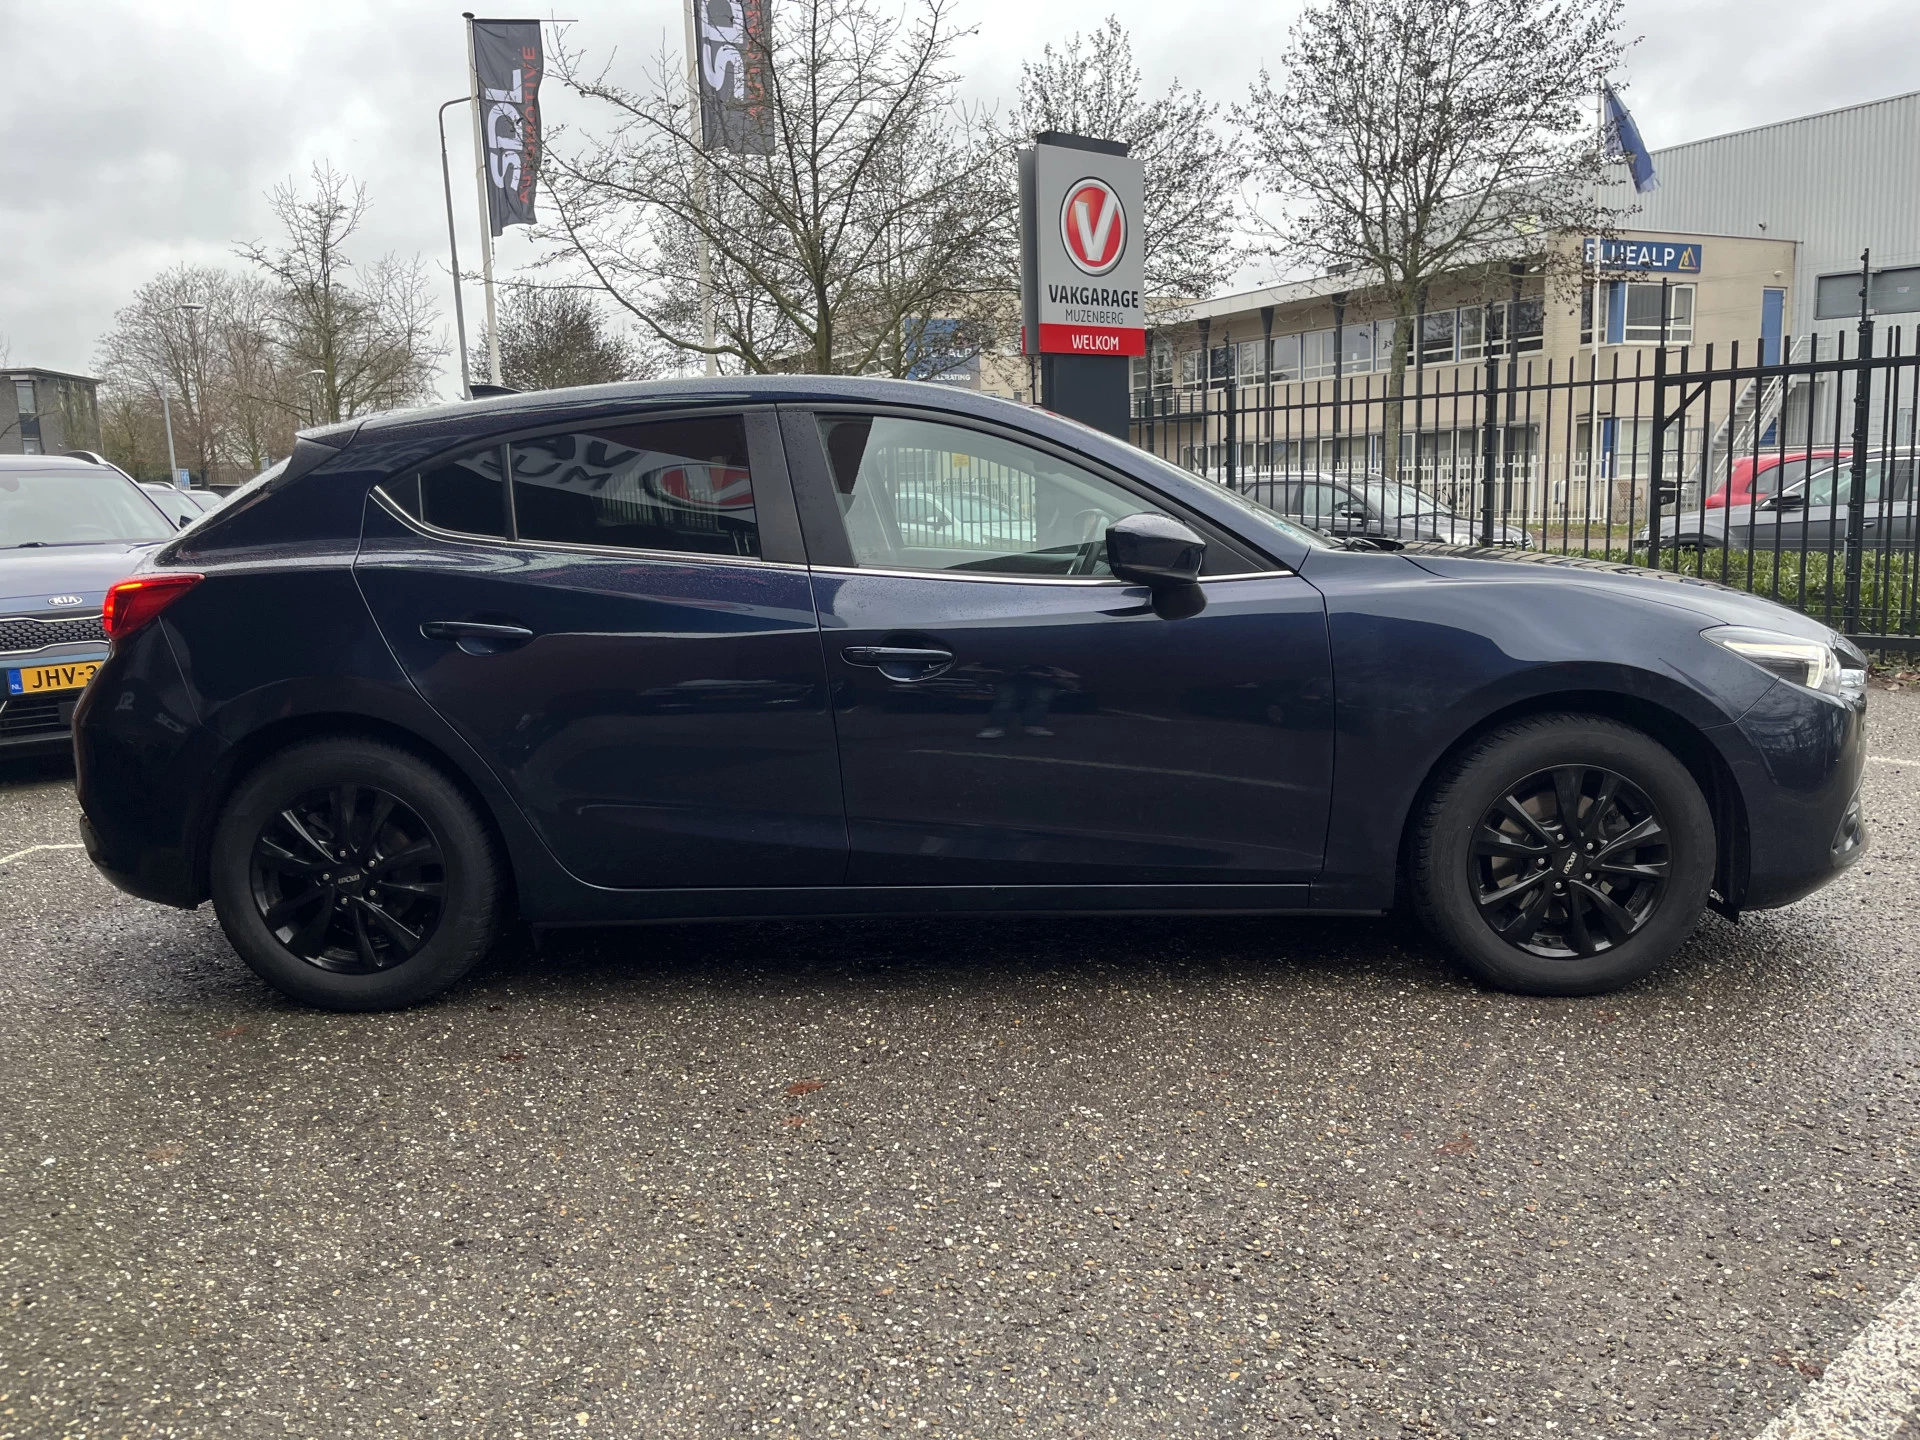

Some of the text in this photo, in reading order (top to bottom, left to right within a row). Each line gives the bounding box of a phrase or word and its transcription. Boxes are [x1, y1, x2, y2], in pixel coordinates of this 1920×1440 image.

[485, 68, 524, 192] SDL
[1048, 284, 1139, 309] VAKGARAGE
[1065, 309, 1124, 325] MUZENBERG
[1071, 334, 1120, 351] WELKOM
[52, 595, 78, 604] KIA
[32, 665, 98, 689] JHV-3
